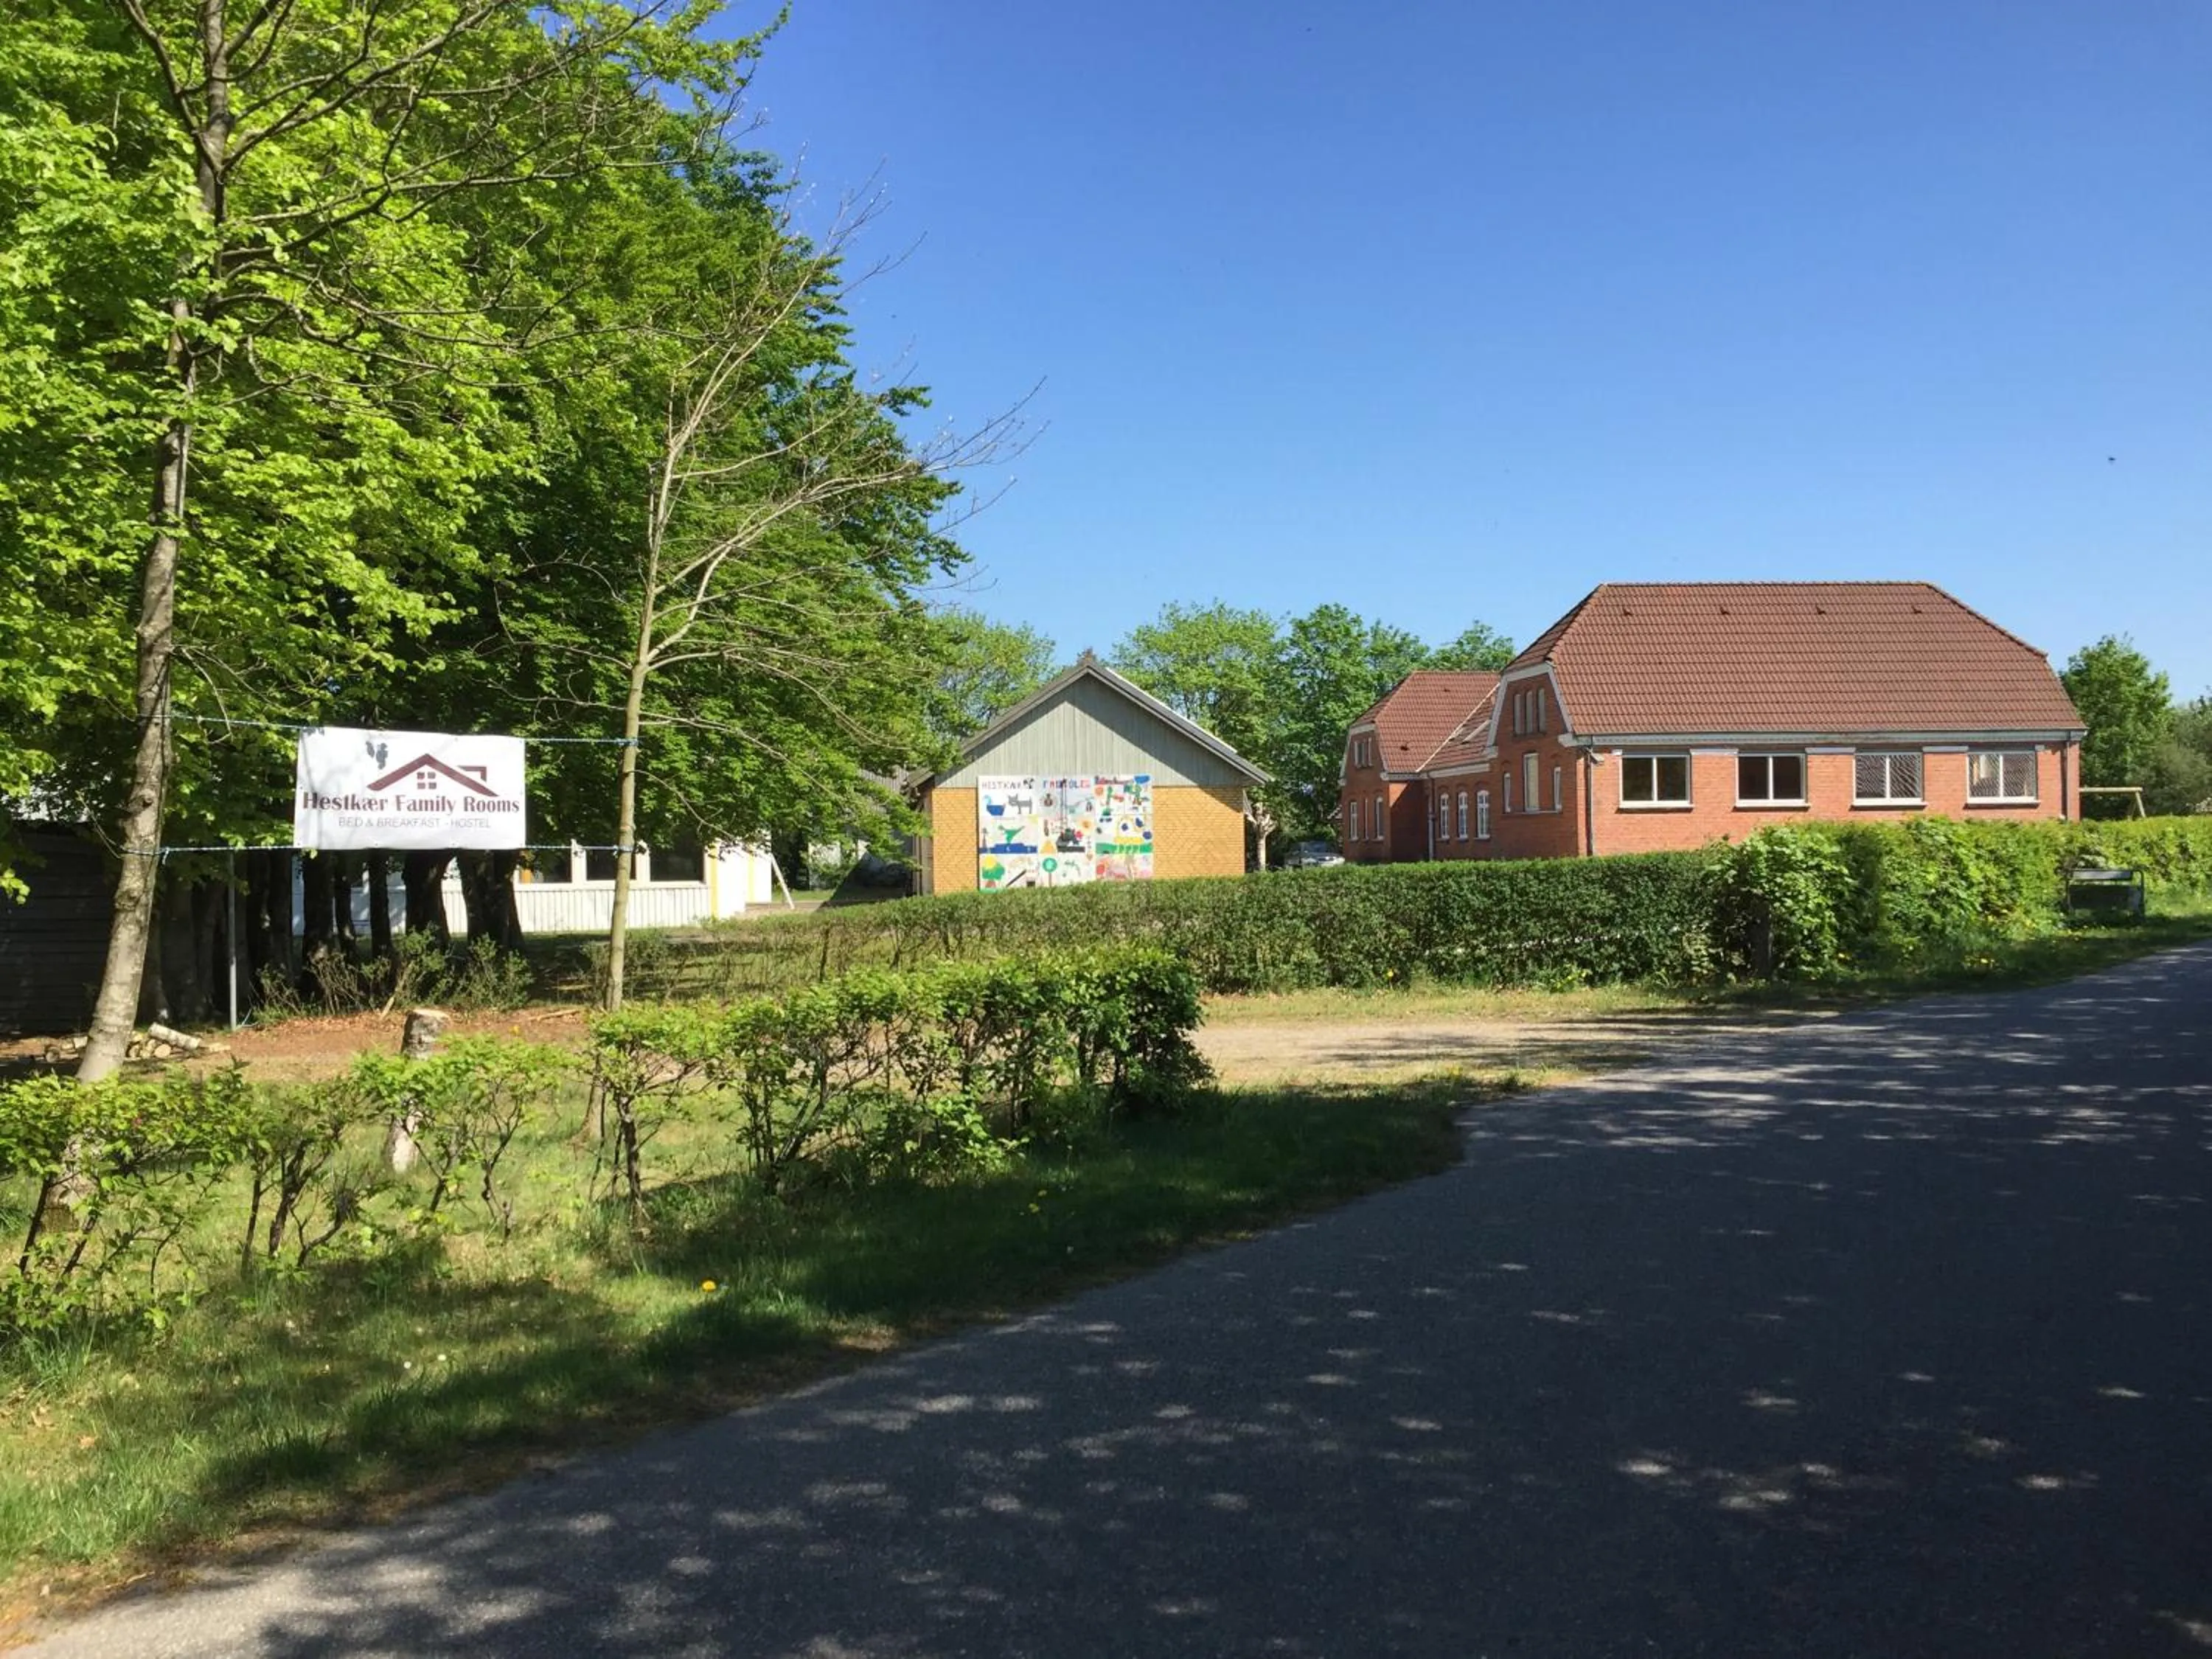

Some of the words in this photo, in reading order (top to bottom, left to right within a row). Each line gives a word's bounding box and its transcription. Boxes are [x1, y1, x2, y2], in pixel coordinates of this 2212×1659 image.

[303, 791, 388, 811] Hestkær
[395, 794, 456, 816] Family
[463, 796, 520, 813] Rooms
[338, 816, 364, 827] BED
[366, 817, 374, 827] &
[377, 817, 440, 827] BREAKFAST
[451, 818, 490, 828] HOSTEL
